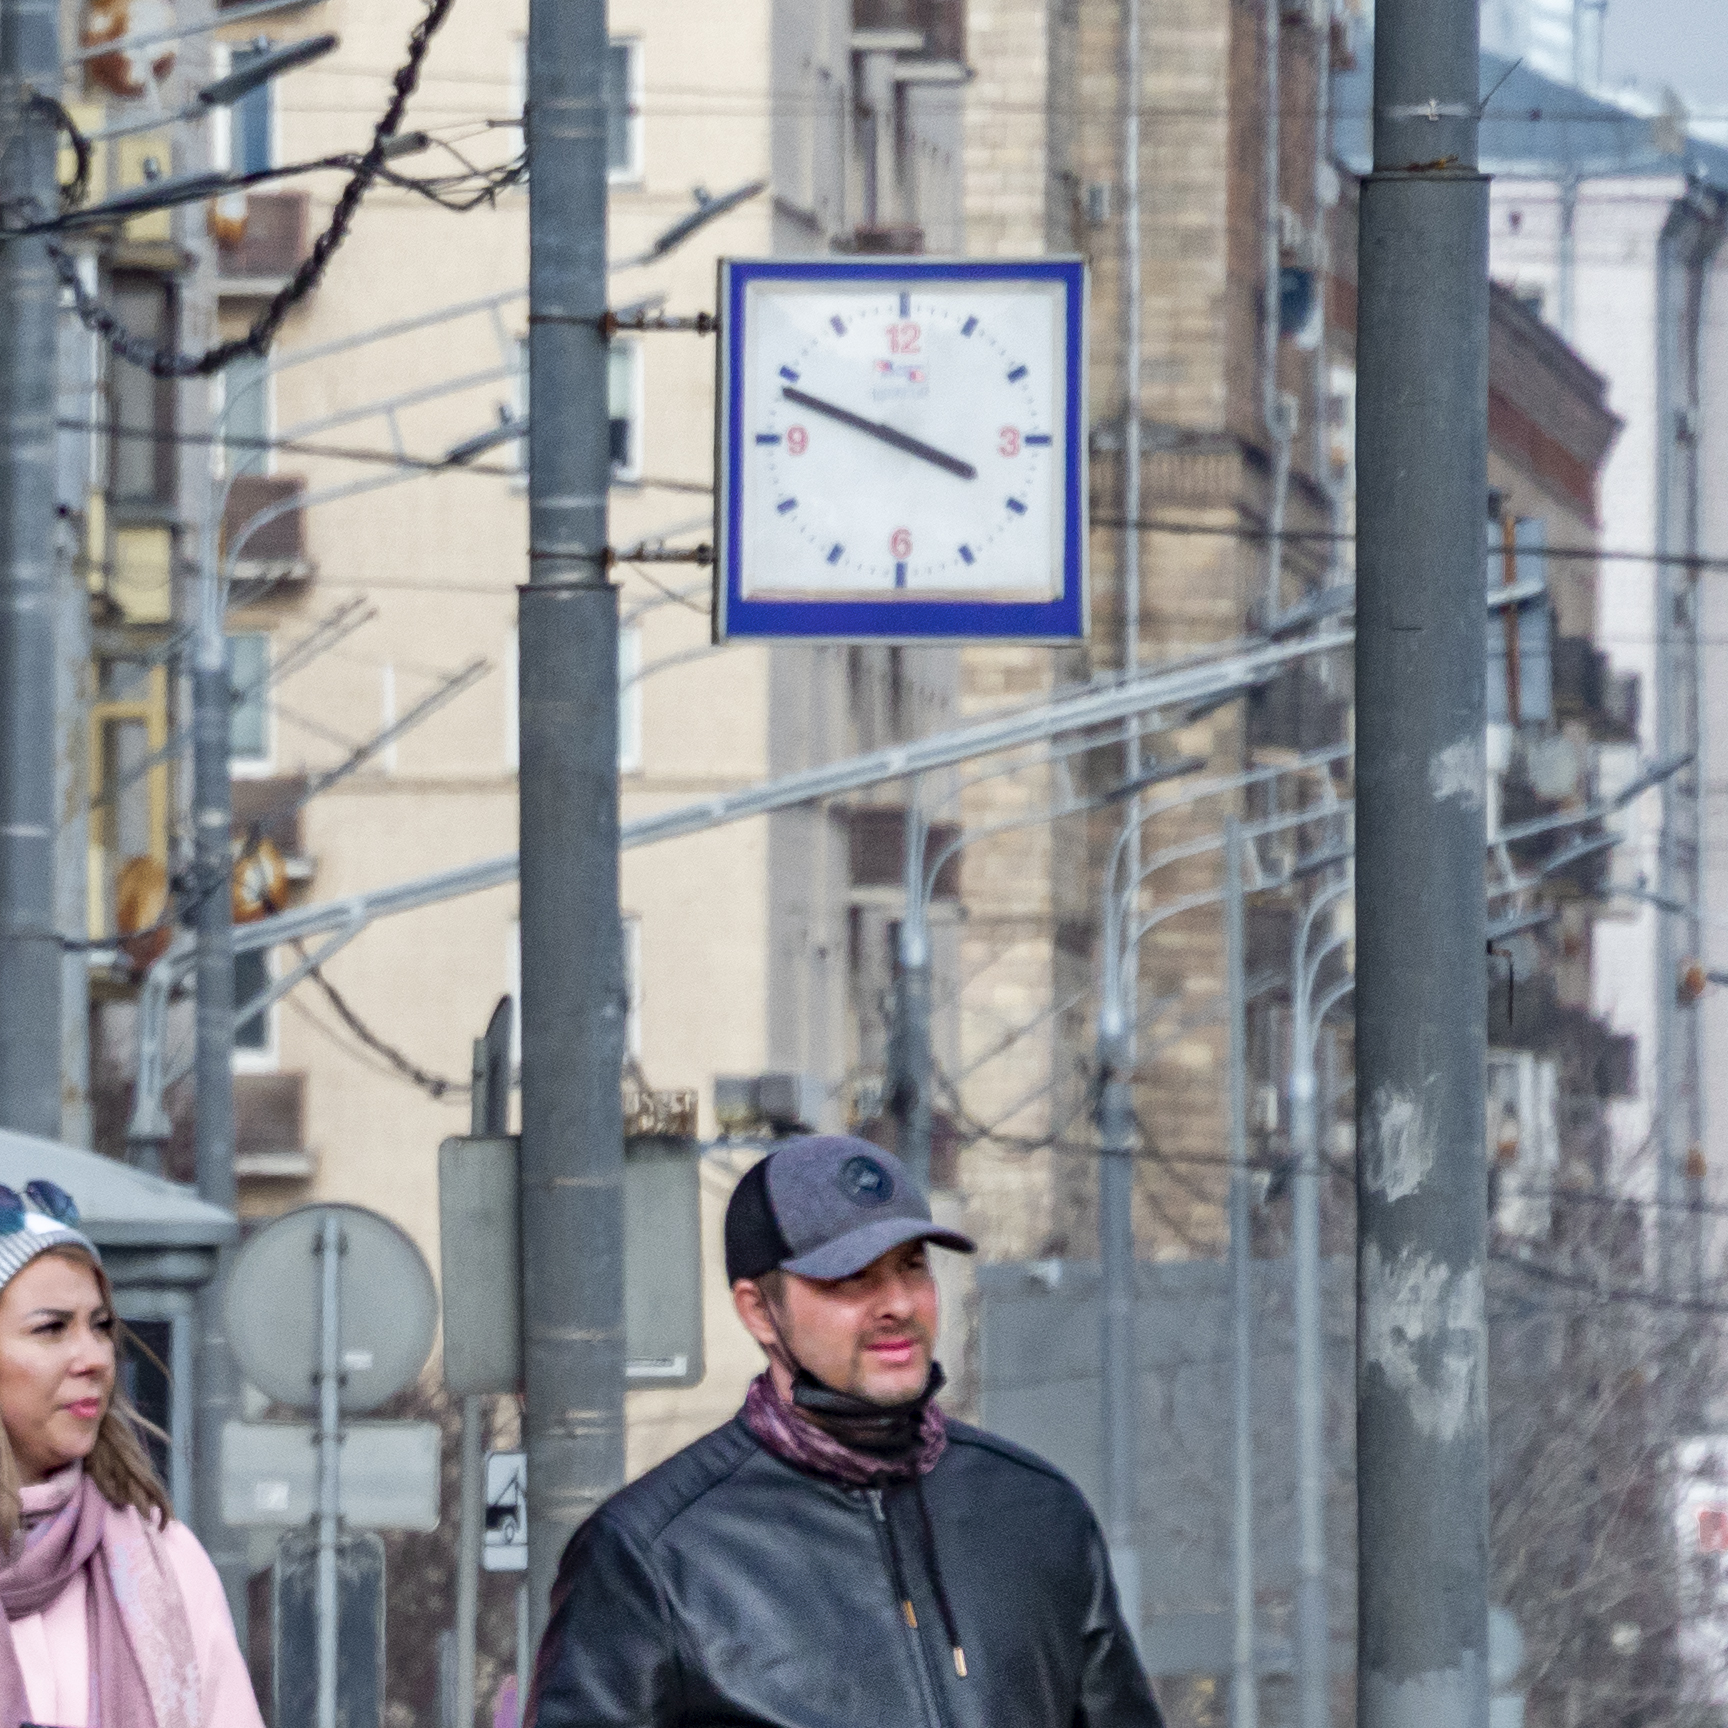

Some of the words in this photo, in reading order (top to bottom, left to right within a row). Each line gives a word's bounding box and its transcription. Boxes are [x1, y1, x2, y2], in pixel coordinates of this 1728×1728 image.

[885, 323, 921, 354] 12
[787, 426, 808, 455] 9
[999, 426, 1020, 457] 3
[891, 528, 911, 559] 6
